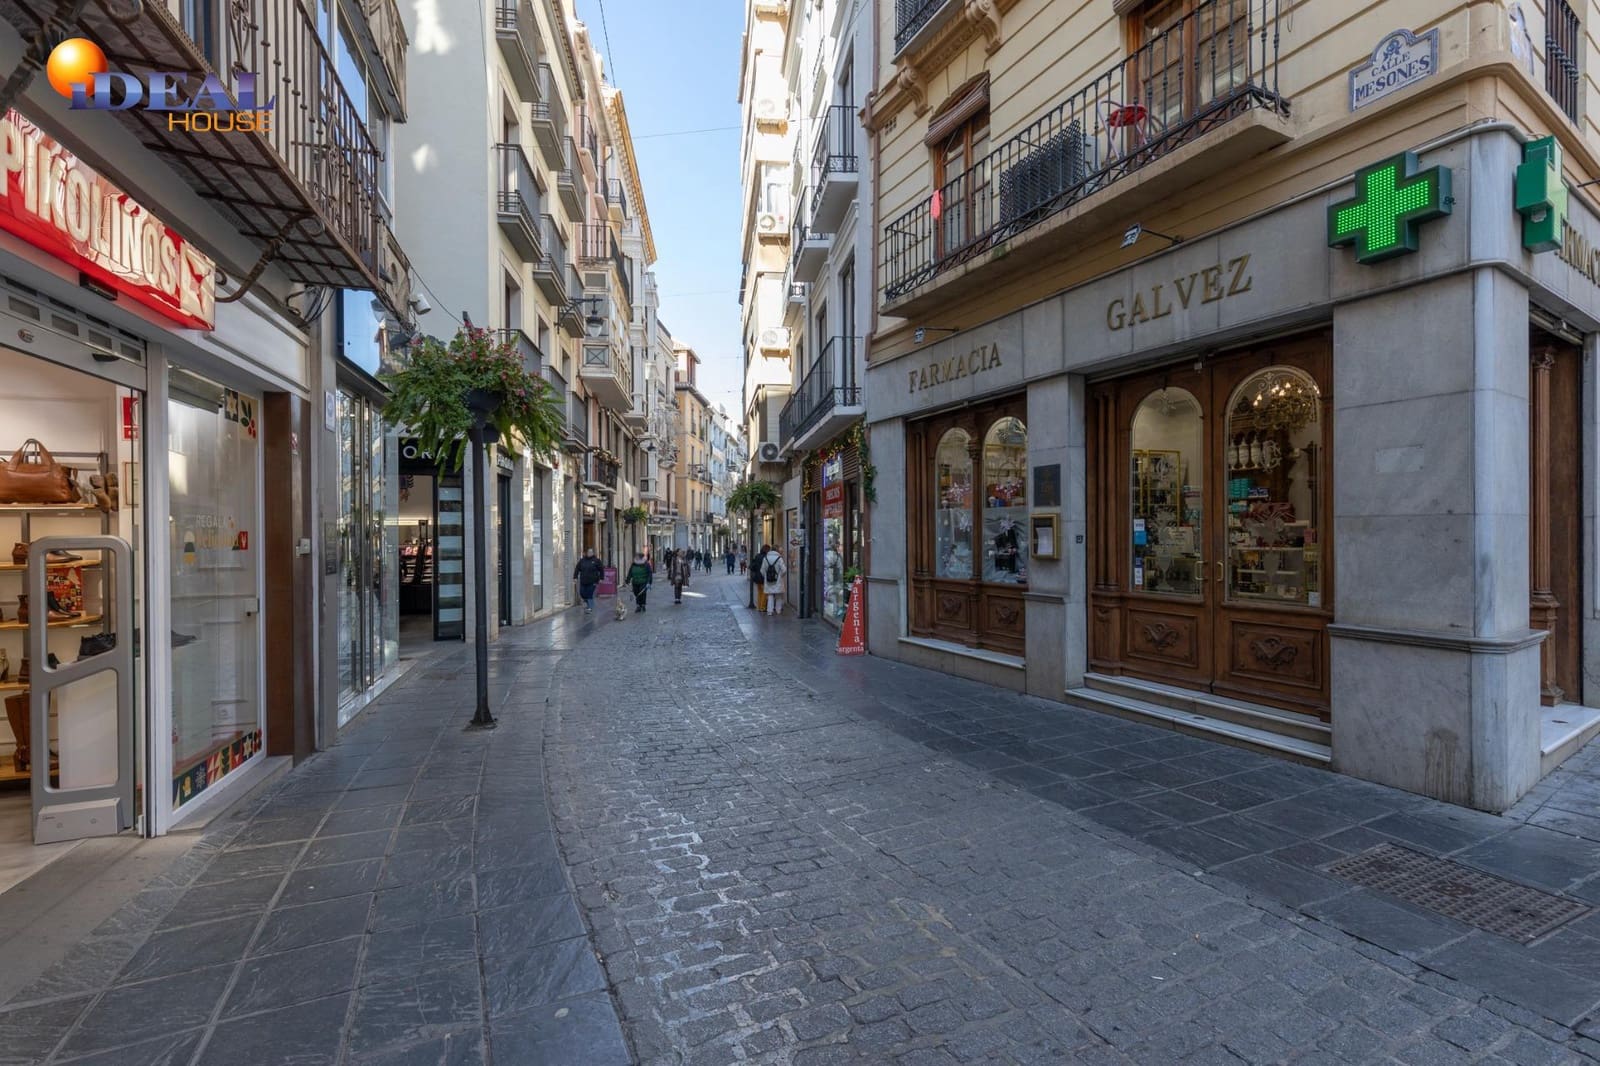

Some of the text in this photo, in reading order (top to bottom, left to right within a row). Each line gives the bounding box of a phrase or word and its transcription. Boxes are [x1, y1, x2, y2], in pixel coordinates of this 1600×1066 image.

[1355, 55, 1430, 102] MESONES
[1371, 51, 1411, 77] CALLE
[0, 117, 177, 296] PIKOLINOS
[1106, 254, 1252, 331] GALVEZ
[908, 342, 1002, 394] FARMACIA
[852, 586, 861, 643] argenta
